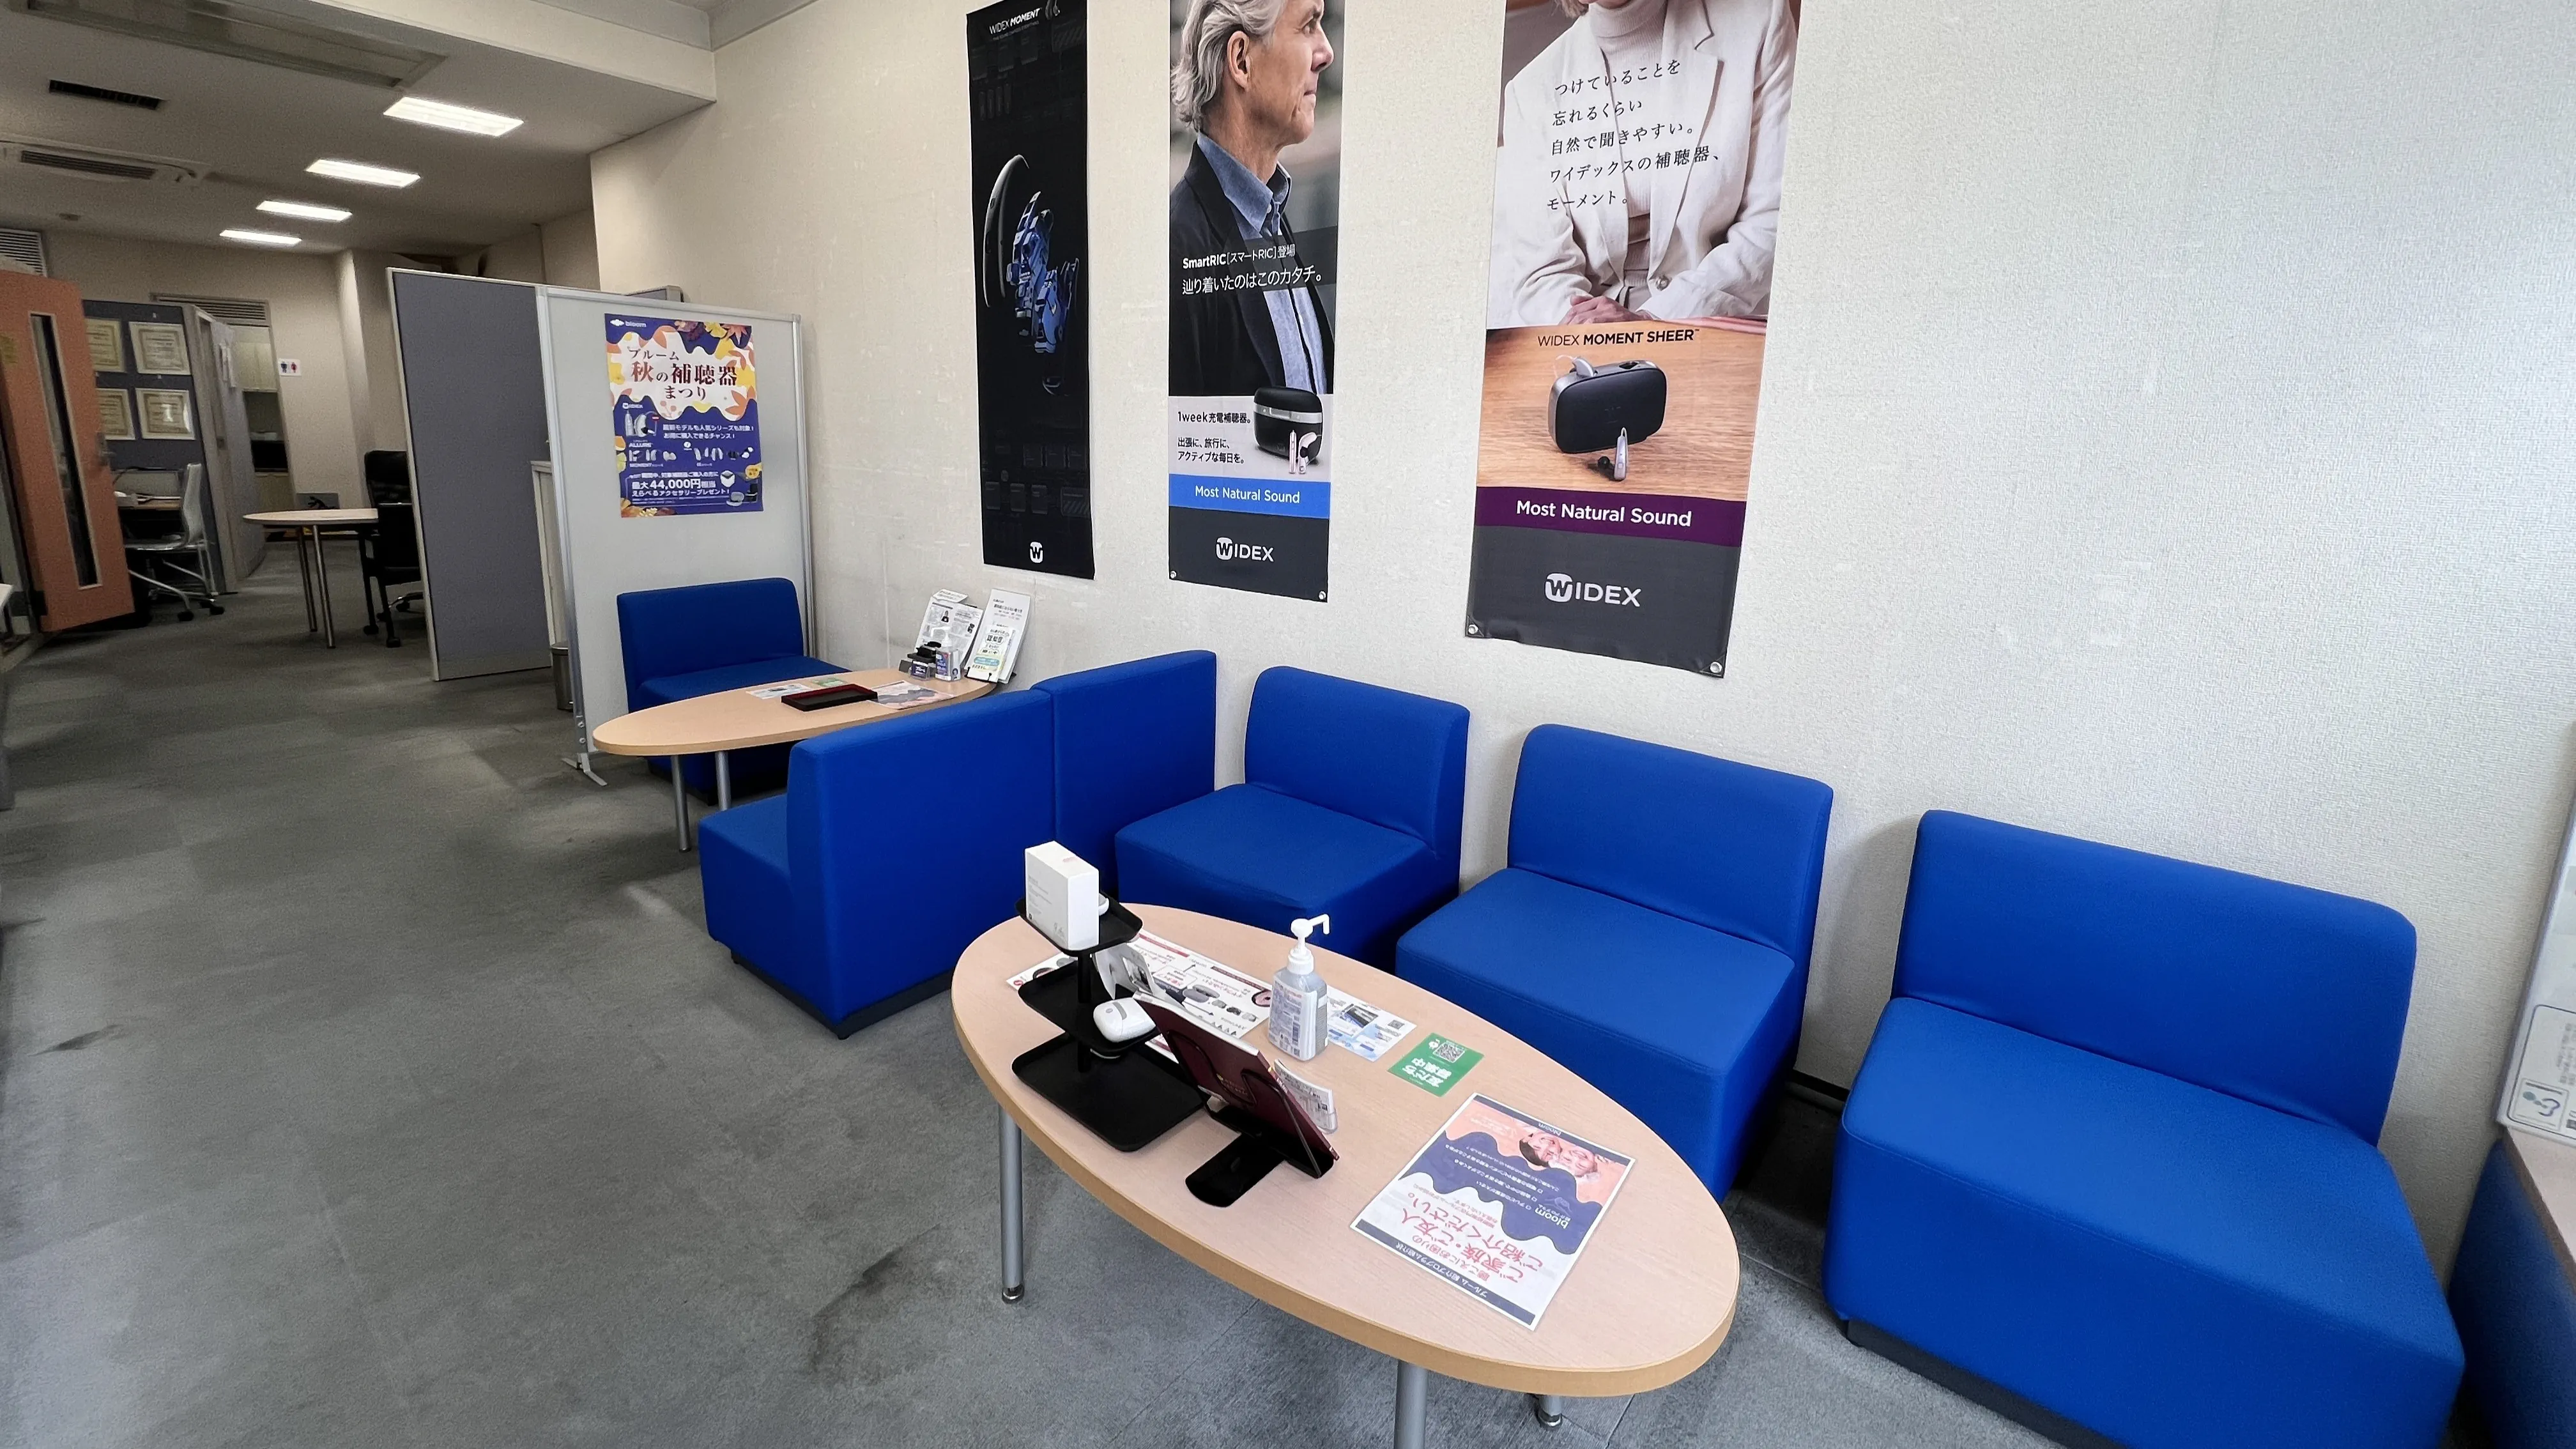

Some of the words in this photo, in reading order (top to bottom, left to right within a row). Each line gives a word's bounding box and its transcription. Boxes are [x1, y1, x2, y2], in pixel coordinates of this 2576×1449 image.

[989, 19, 1010, 34] WIDEX
[1009, 8, 1041, 26] MOMENT
[1554, 59, 1680, 96] つけていることを
[1552, 100, 1642, 126] 忘れるくらい
[1551, 122, 1694, 156] 自然で聞きやすい。
[1550, 145, 1721, 183] ワイデックスの補聴器、
[1547, 190, 1628, 211] モーメント。
[1182, 264, 1322, 295] 辿り着いたのはこのカタチ。
[1537, 334, 1579, 347] WIDEX
[1583, 332, 1644, 345] MOMENT
[629, 349, 679, 361] ブルーム
[631, 361, 737, 387] 秋の補聴器
[664, 387, 707, 401] まつり
[1177, 437, 1230, 449] 出張に、旅行に、
[1177, 451, 1244, 464] アクティブな毎日を。
[1195, 486, 1219, 498] Most
[1222, 487, 1261, 501] Natural
[1264, 491, 1301, 503] Sound
[1517, 500, 1556, 516] Most
[1561, 504, 1624, 522] Natural
[1631, 508, 1691, 528] Sound
[1216, 537, 1274, 562] WIDEX
[1544, 572, 1641, 607] WIDEX
[1532, 1206, 1569, 1229] bloom
[1400, 1192, 1545, 1273] ご紹介ください。
[1393, 1208, 1526, 1285] ご家族・ご友人
